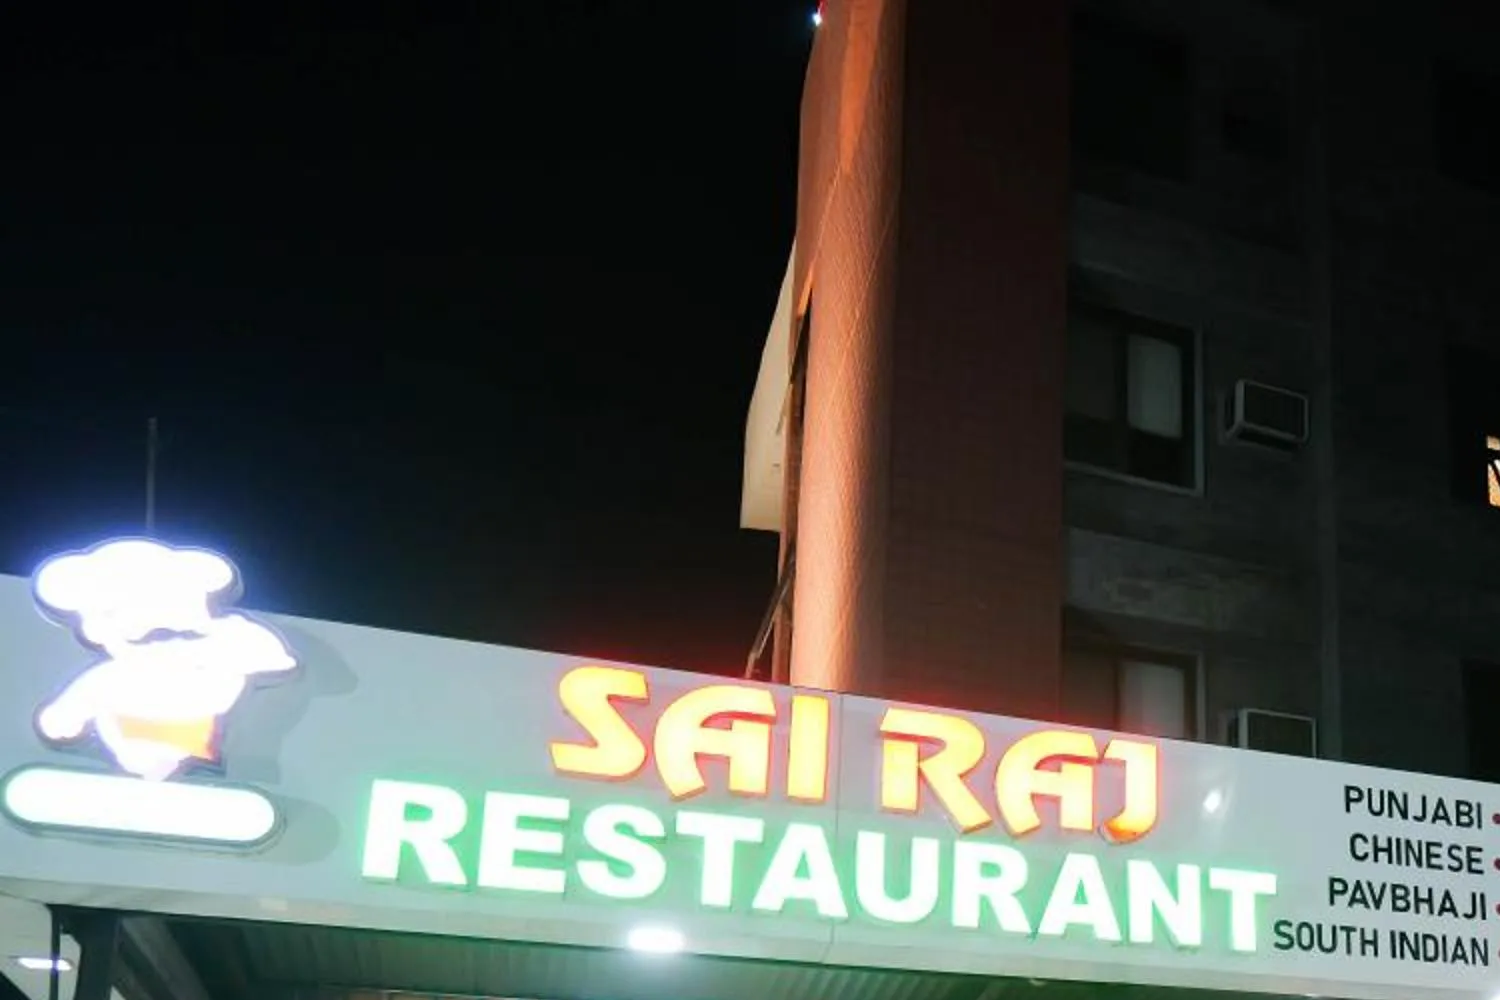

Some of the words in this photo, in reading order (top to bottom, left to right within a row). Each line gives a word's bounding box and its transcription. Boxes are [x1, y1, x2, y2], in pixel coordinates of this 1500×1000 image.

[549, 666, 831, 801] SAI
[880, 706, 1160, 844] RAJ
[1344, 785, 1482, 830] PUNJABI
[361, 778, 1278, 952] RESTAURANT
[1350, 833, 1485, 875] CHINESE
[1328, 877, 1487, 921] PAVBHAJI
[1274, 920, 1378, 957] SOUTH
[1390, 930, 1489, 967] INDIAN
